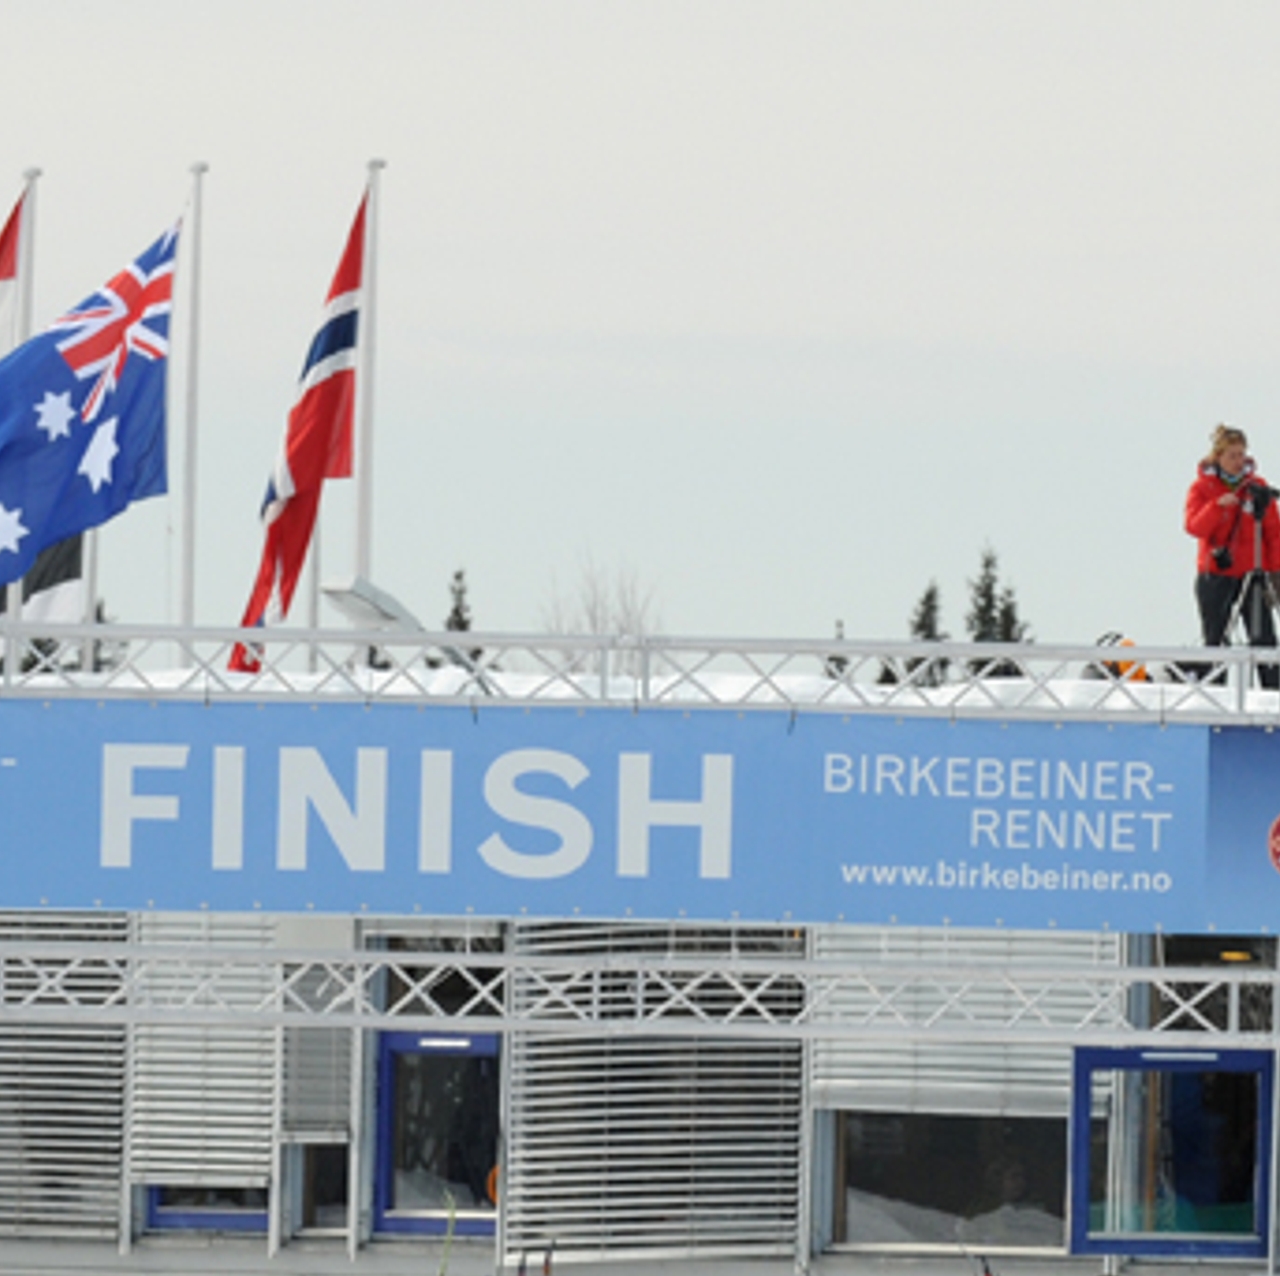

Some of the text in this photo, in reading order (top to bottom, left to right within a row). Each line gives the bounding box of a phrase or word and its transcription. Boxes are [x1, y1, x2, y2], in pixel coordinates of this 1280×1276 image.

[823, 752, 1174, 801] BIRKEBEINER-
[100, 743, 734, 880] FINISH
[971, 809, 1173, 852] RENNET
[842, 861, 1173, 892] www.birkebeiner.no
